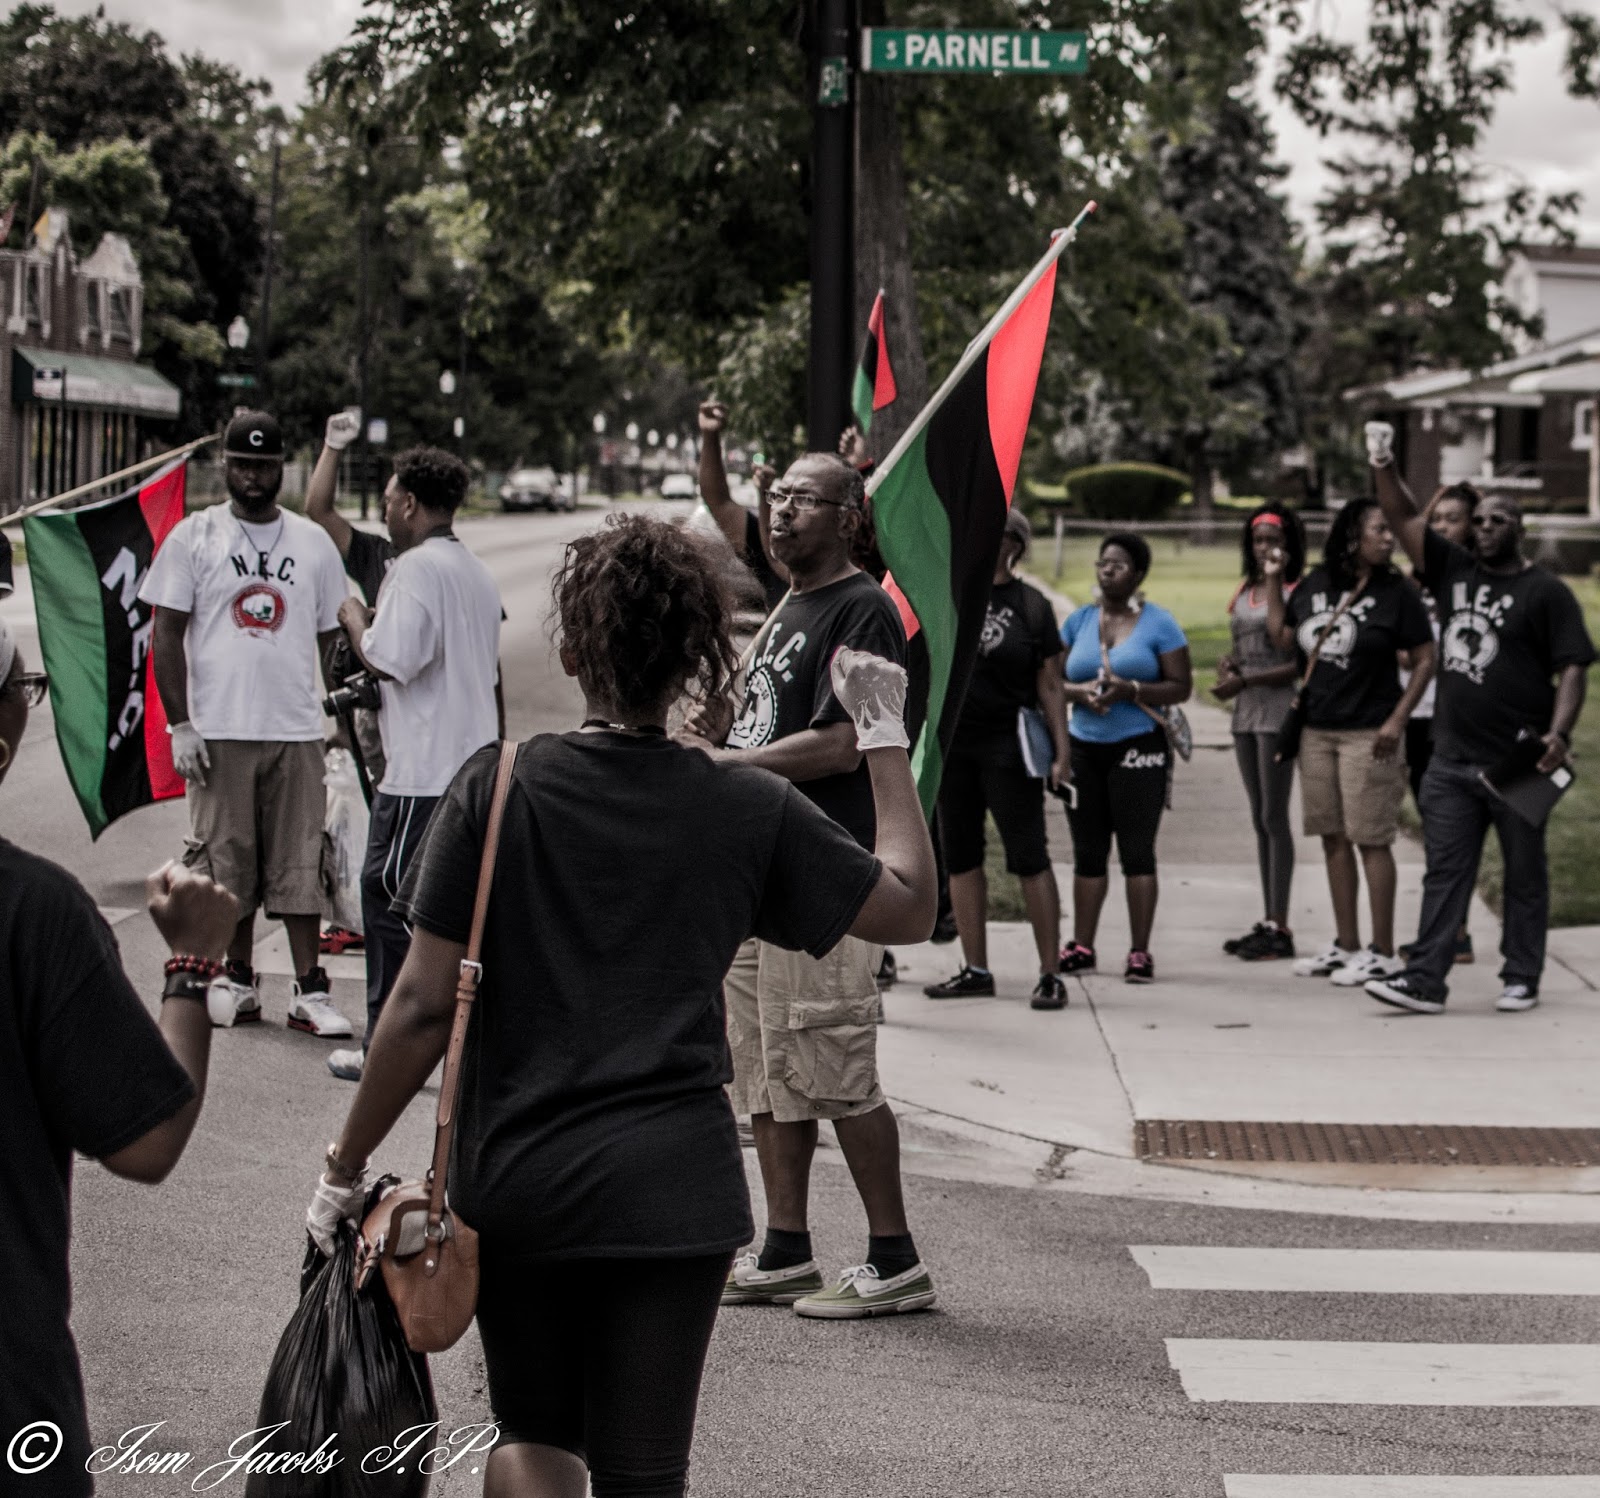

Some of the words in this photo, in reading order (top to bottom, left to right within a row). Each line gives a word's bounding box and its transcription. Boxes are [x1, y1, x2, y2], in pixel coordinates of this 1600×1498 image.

[886, 40, 898, 60] S
[905, 34, 1050, 68] PARNELL
[249, 430, 264, 446] C
[231, 551, 295, 586] N.E.C.
[1120, 749, 1165, 768] Love
